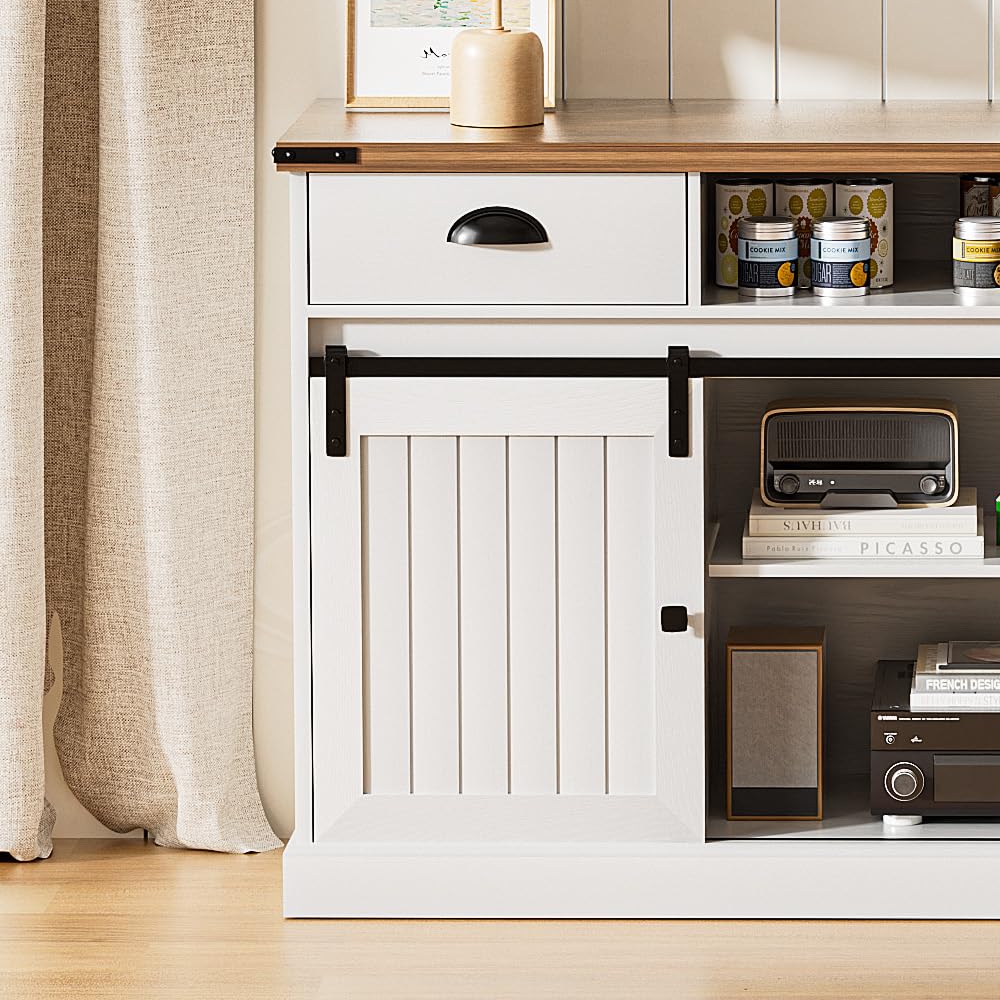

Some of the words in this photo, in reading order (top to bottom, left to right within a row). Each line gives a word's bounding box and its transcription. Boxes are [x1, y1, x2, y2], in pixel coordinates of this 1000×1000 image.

[749, 246, 774, 254] COOKIE
[739, 262, 759, 283] UGAR
[860, 542, 963, 555] PICASSO
[926, 679, 968, 690] FRENCH
